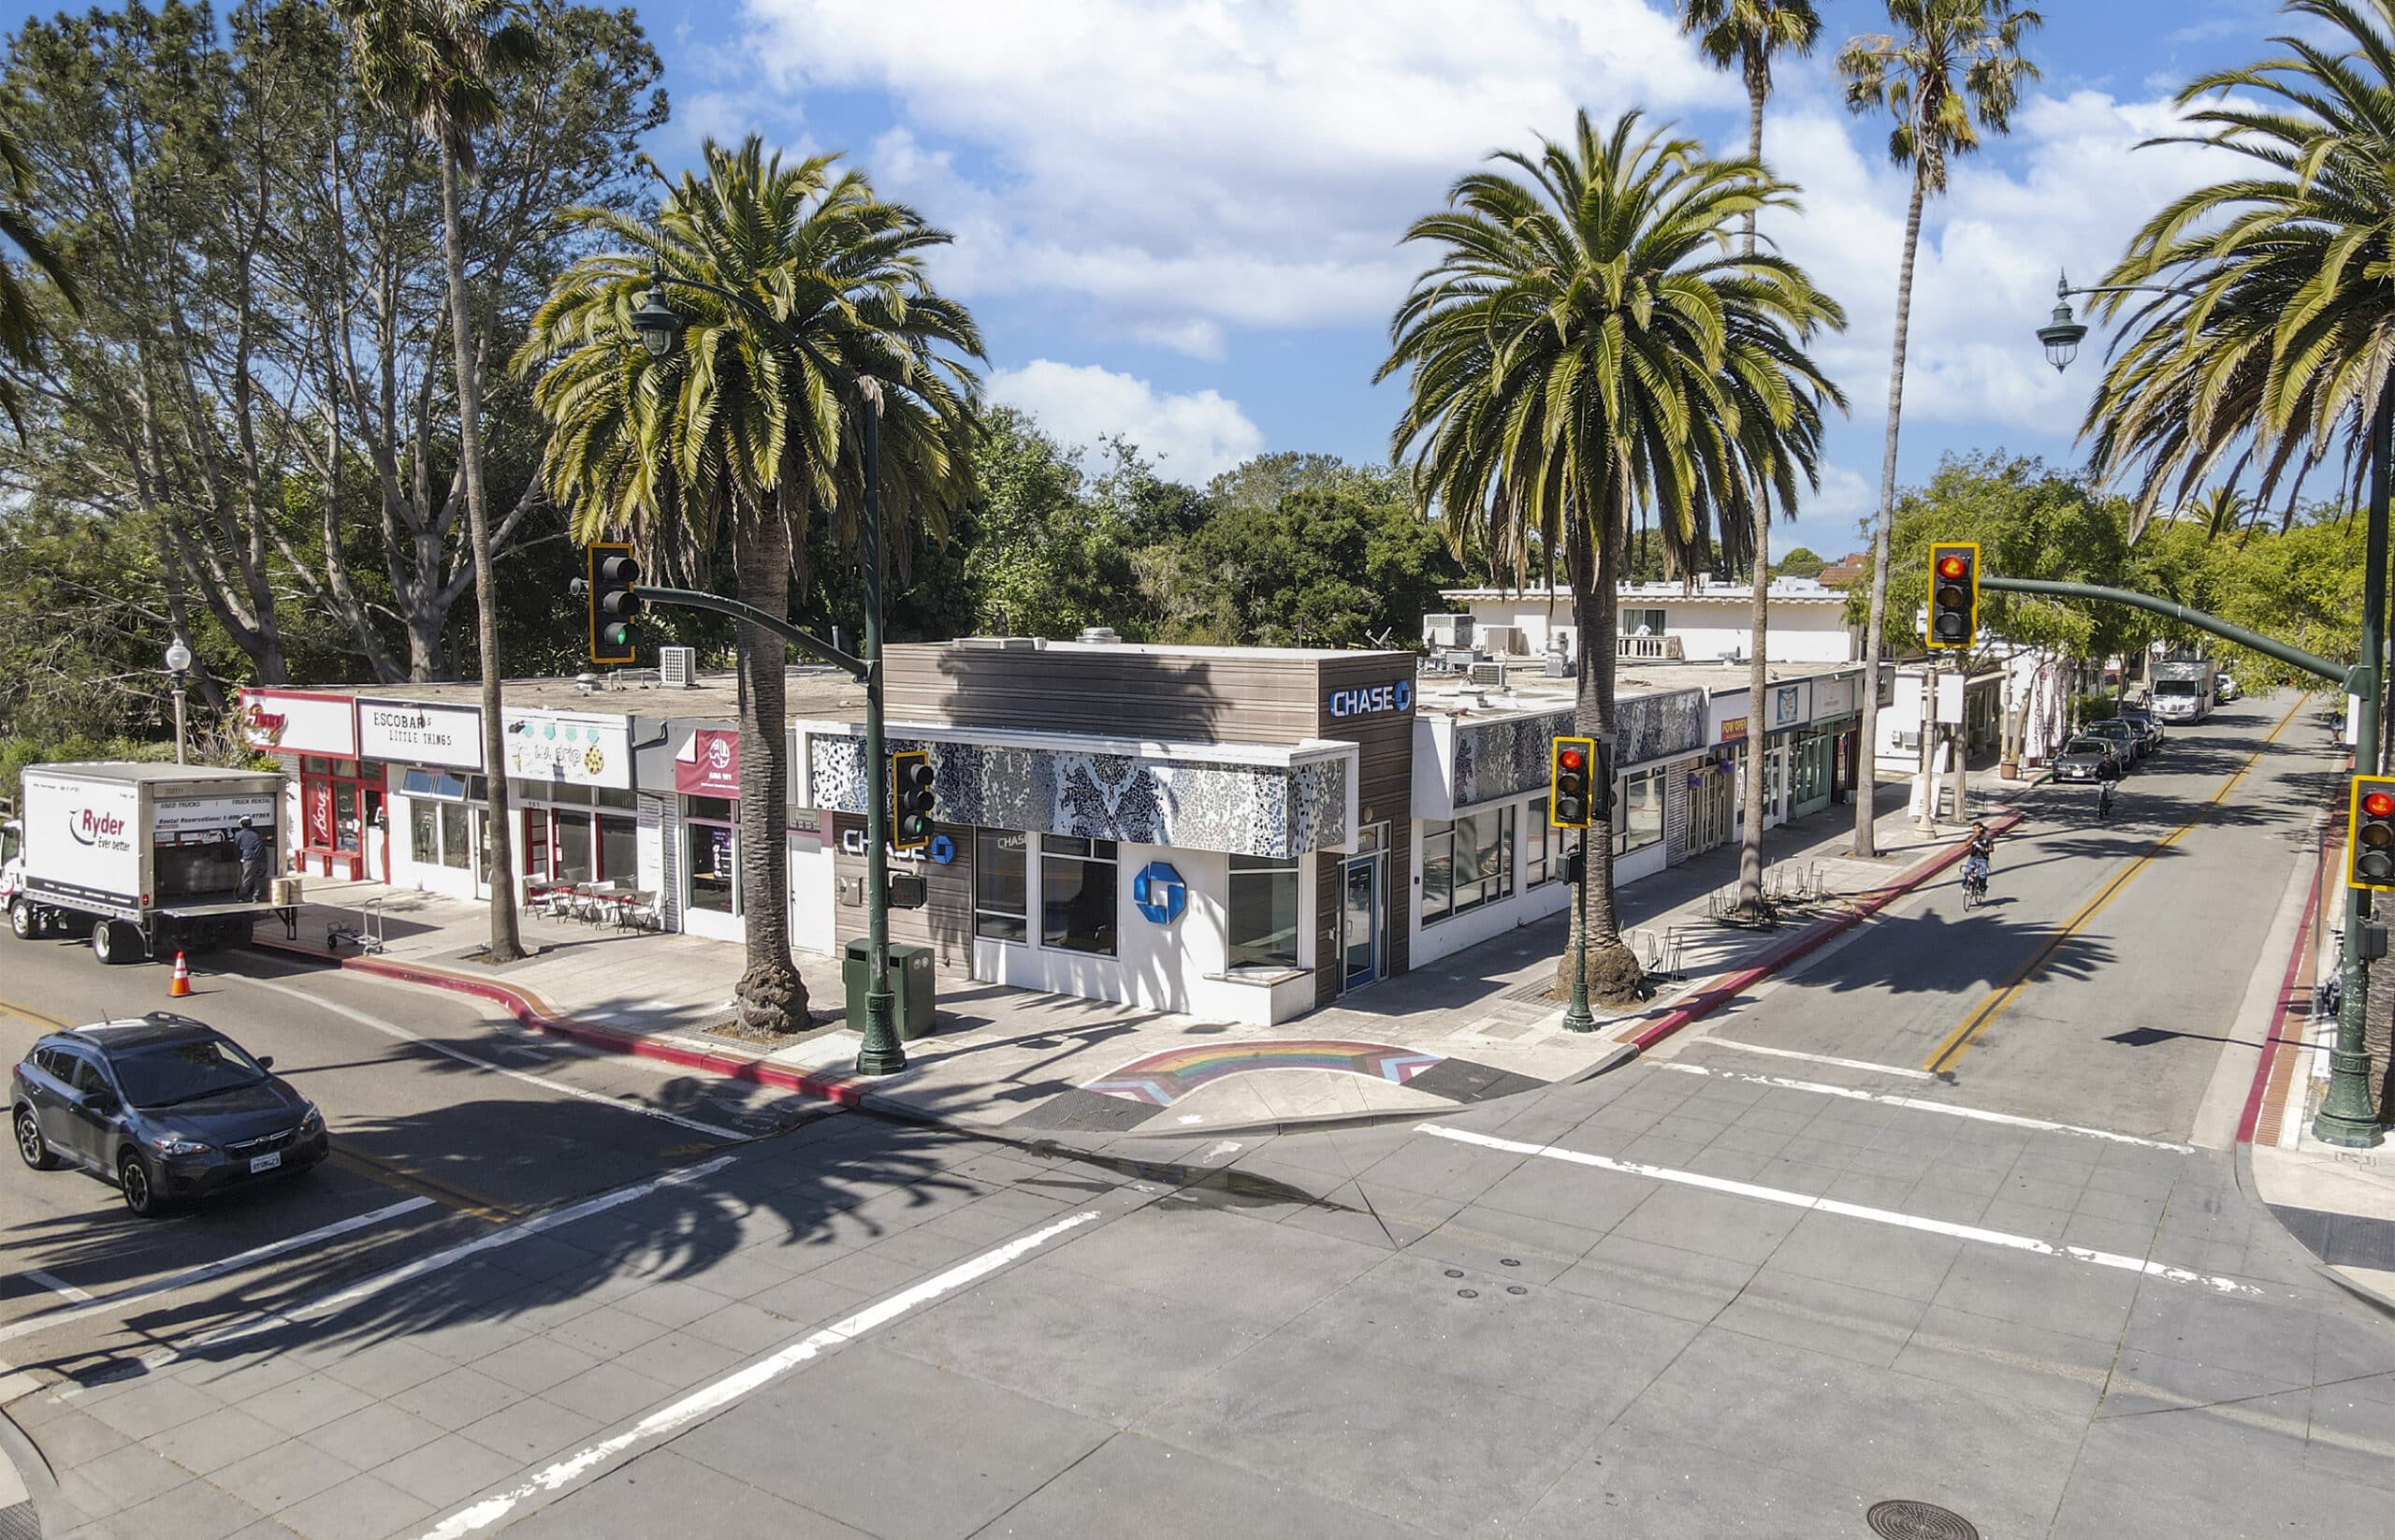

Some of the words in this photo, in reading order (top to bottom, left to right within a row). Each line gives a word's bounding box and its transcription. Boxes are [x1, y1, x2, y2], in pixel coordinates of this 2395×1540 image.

[1332, 686, 1394, 718] CHASE
[389, 730, 418, 743] LITTLE
[423, 733, 452, 746] THINGS
[82, 808, 125, 838] Ryder
[98, 835, 110, 849] Ever
